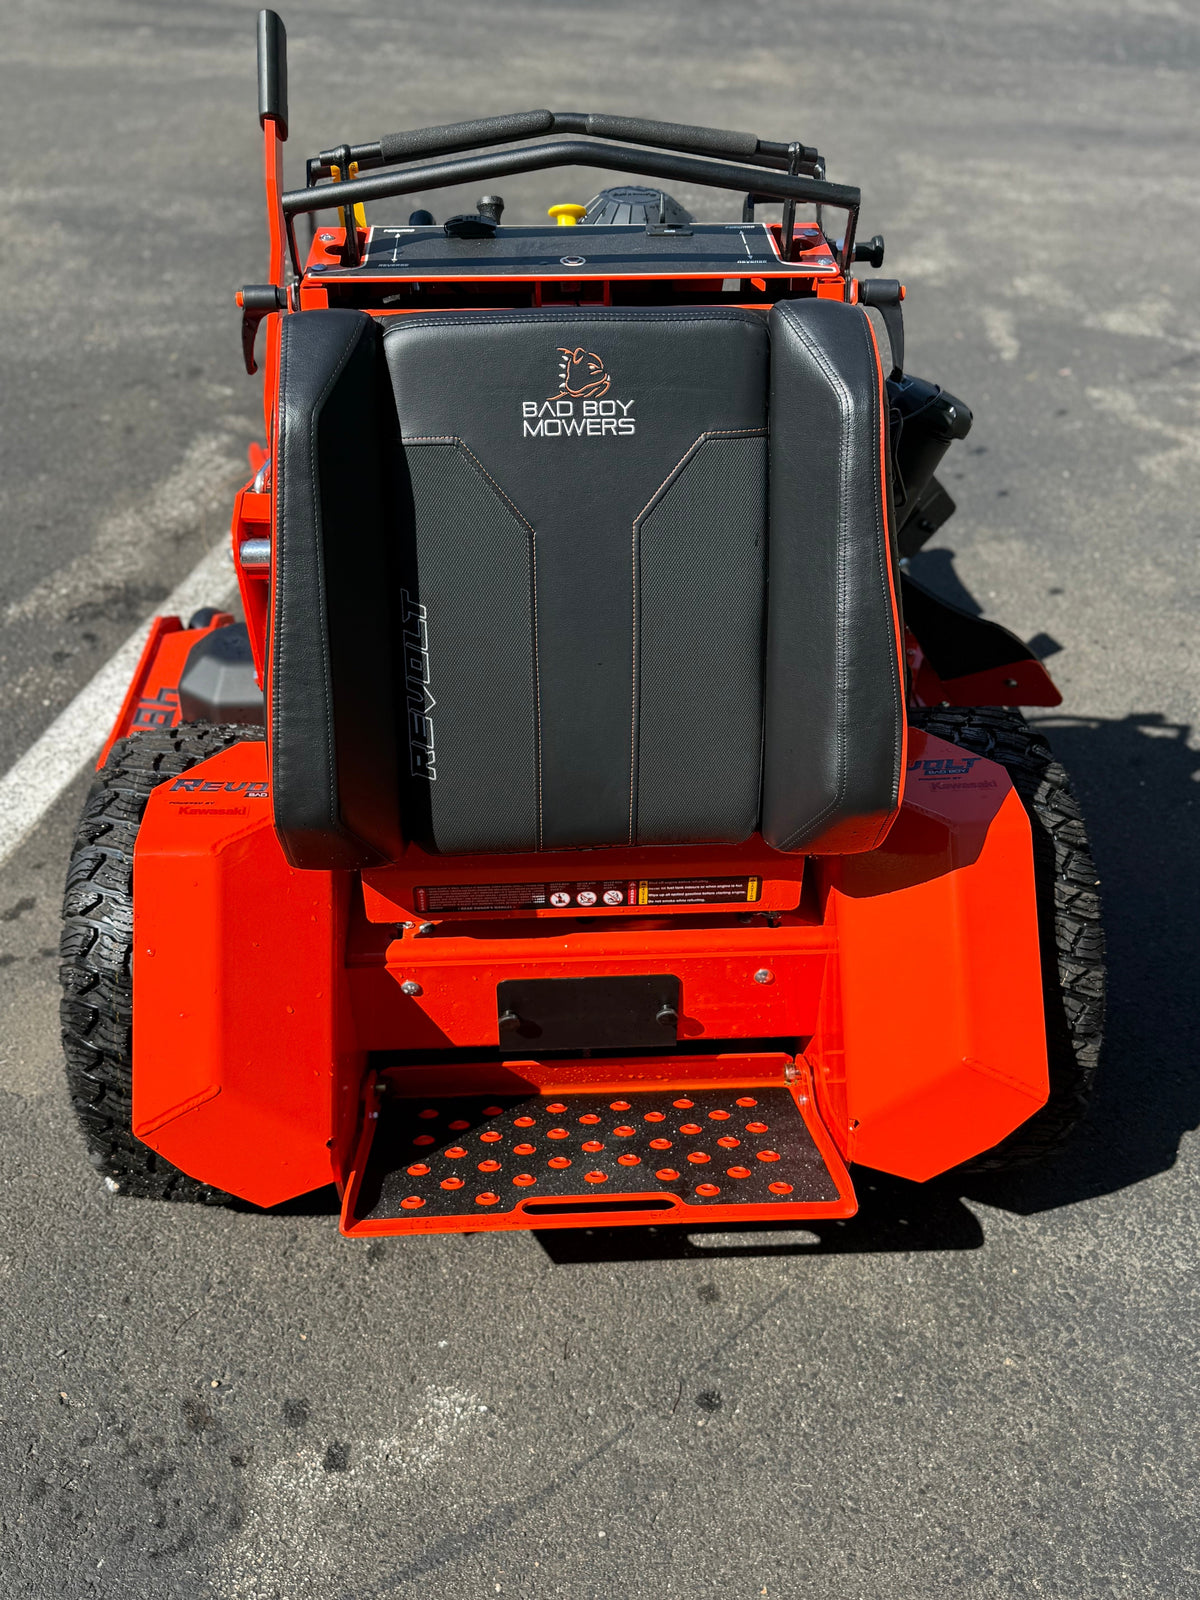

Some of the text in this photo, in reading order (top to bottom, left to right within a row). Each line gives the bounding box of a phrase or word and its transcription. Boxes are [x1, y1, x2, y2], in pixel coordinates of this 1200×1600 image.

[522, 399, 635, 417] BAD BOY
[523, 418, 636, 437] MOWERS
[400, 588, 437, 781] REVOLT
[169, 778, 270, 792] REVO
[930, 780, 998, 790] Kawasaki
[178, 806, 247, 816] Kawasaki
